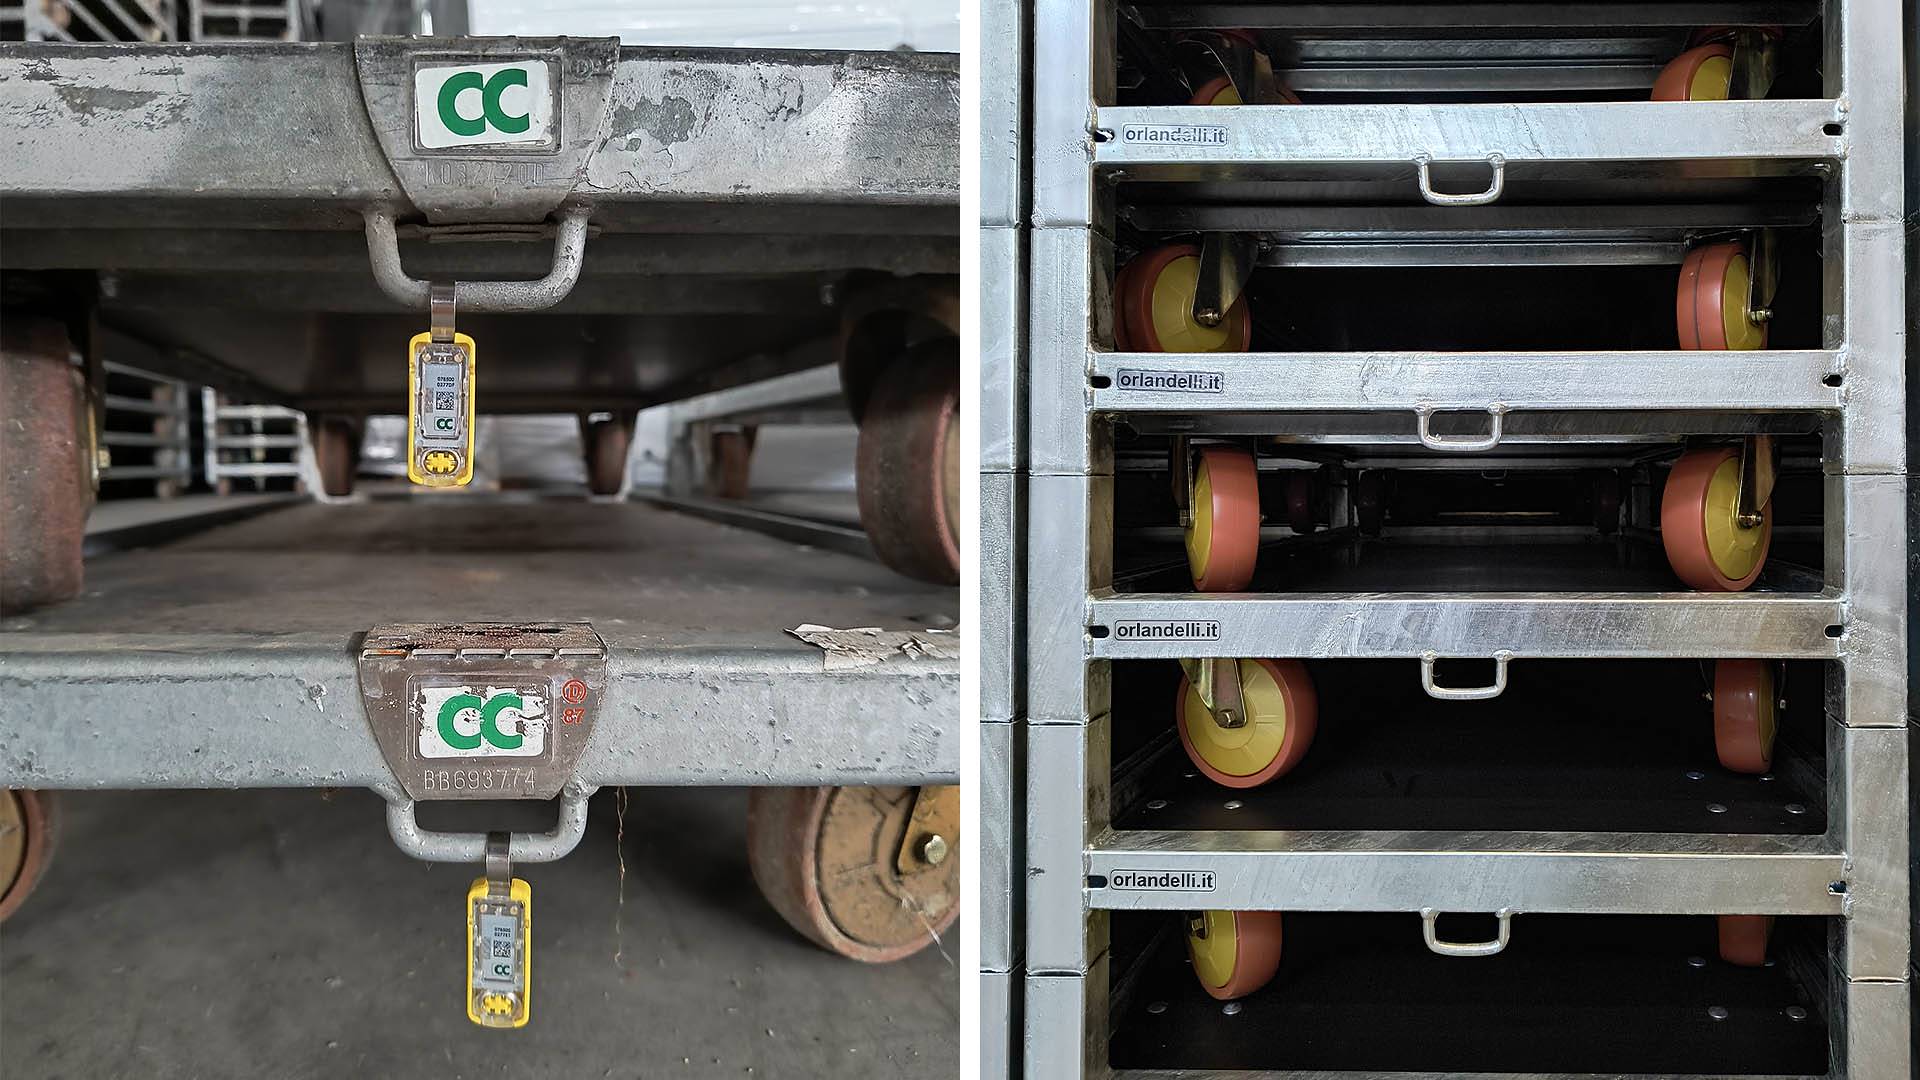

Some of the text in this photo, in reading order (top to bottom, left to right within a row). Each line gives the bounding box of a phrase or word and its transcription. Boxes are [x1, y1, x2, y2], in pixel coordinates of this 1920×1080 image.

[437, 68, 530, 136] CC
[1126, 127, 1225, 143] orlandelli.it
[1120, 373, 1220, 389] orlandelli.it
[436, 418, 454, 430] CC
[1117, 623, 1218, 637] orlandelli.it
[437, 692, 523, 750] CC
[562, 708, 585, 725] 87
[1113, 872, 1214, 888] orlandelli.it
[494, 964, 510, 975] CC
